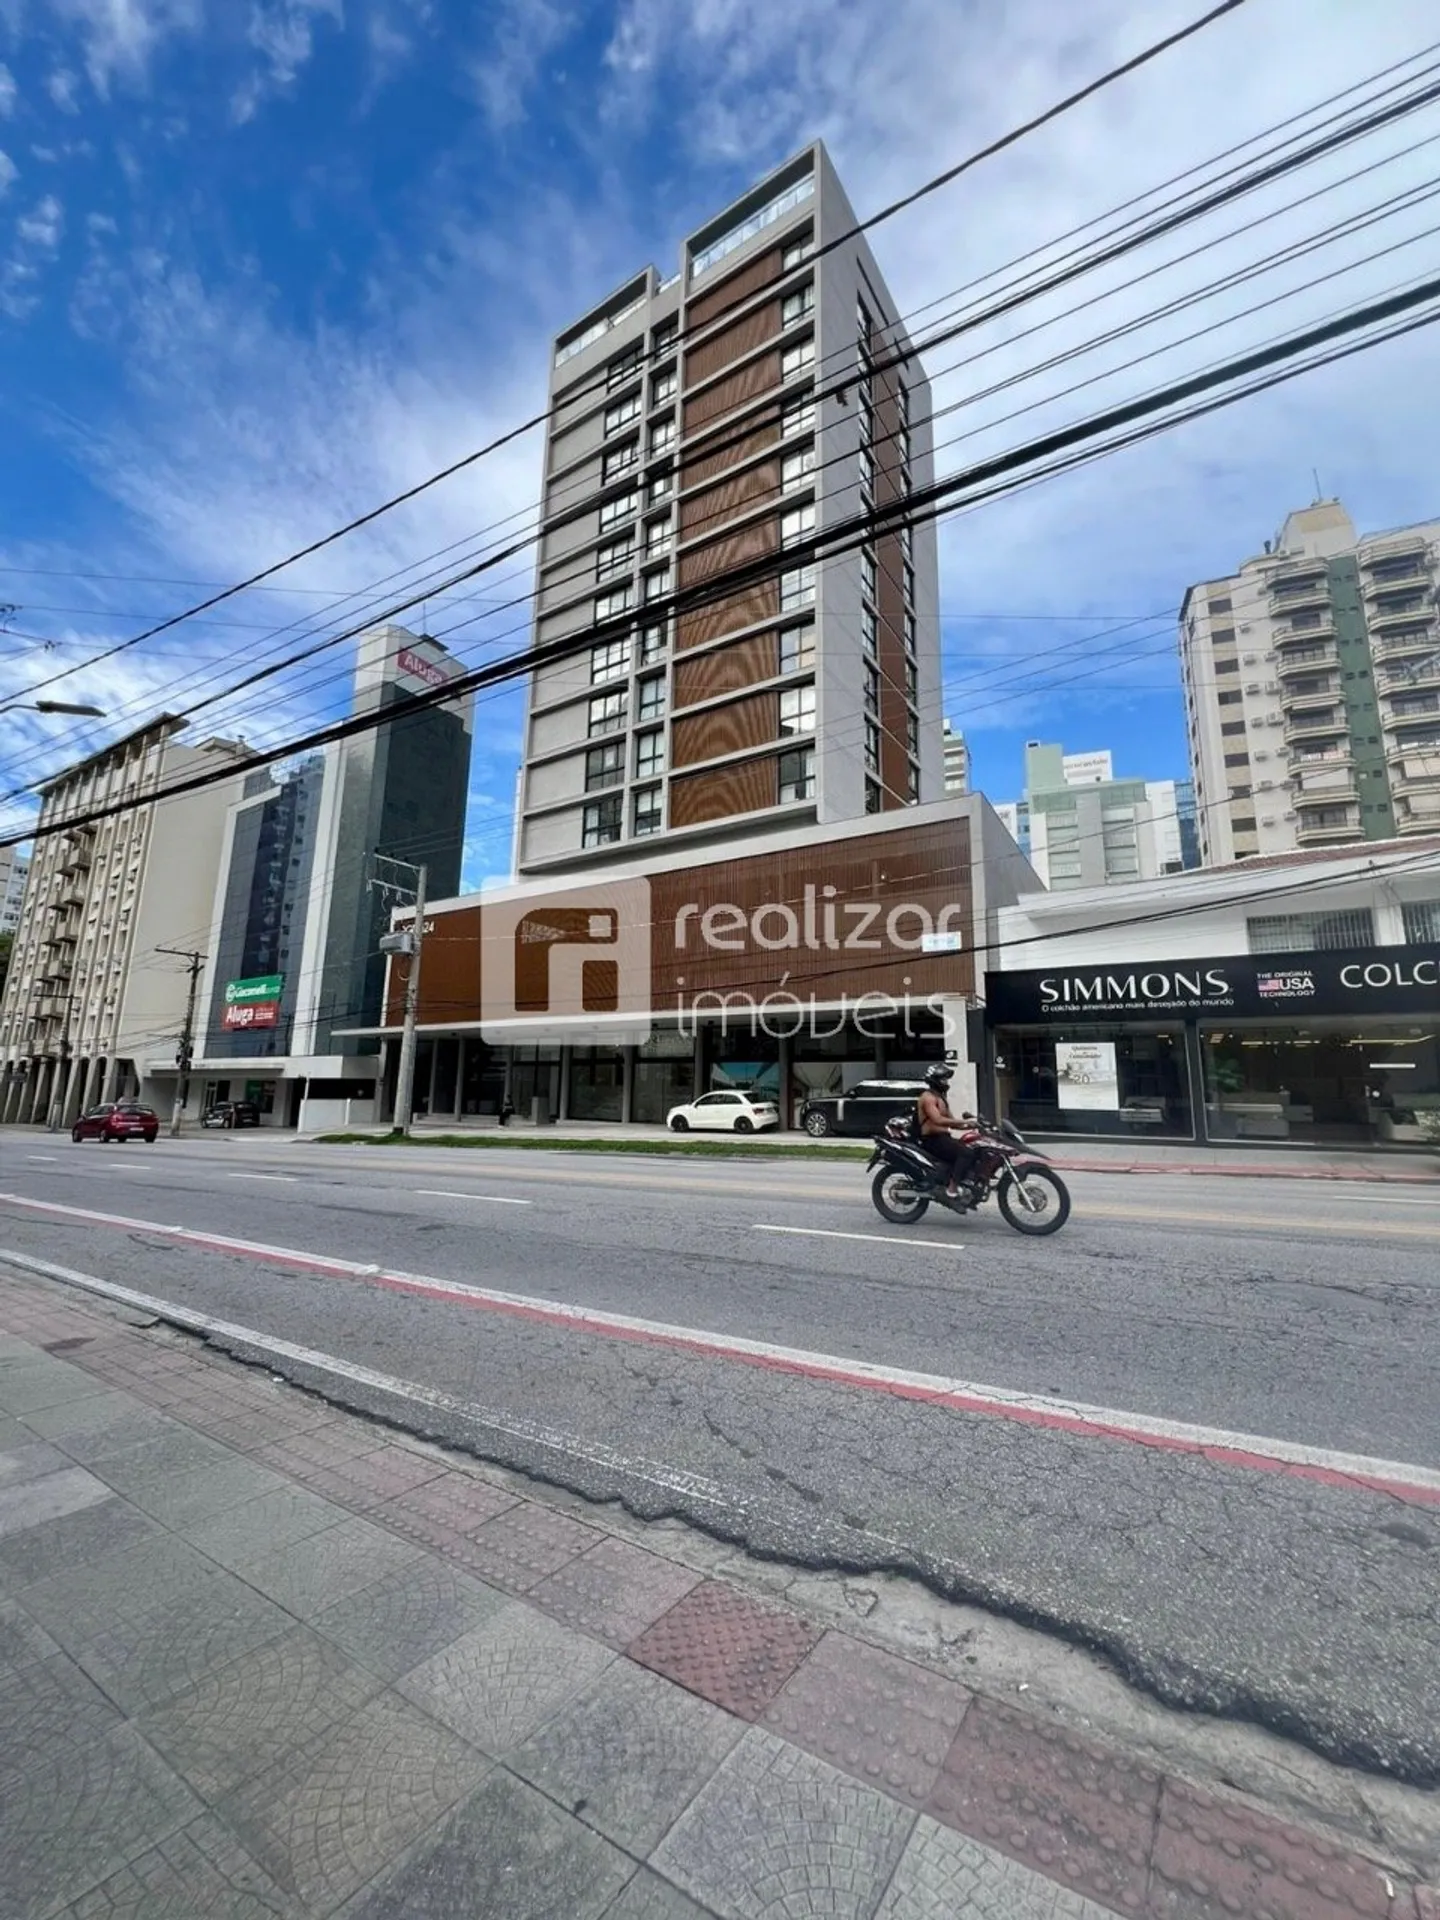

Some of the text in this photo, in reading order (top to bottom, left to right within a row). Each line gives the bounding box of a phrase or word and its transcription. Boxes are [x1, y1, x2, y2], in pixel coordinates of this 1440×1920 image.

[1257, 970, 1313, 980] THE ORIGINAL
[1340, 960, 1440, 988] COLC
[1039, 969, 1230, 1003] SIMMONS
[1279, 977, 1315, 990] USA
[1259, 989, 1316, 998] TECHNOLOGY
[1041, 1004, 1049, 1013] O
[1050, 1003, 1081, 1012] colchão
[1082, 1002, 1124, 1011] americano
[1125, 1001, 1146, 1009] mais
[1188, 998, 1201, 1006] do
[1202, 997, 1235, 1006] mundo
[226, 1005, 254, 1026] Aluga
